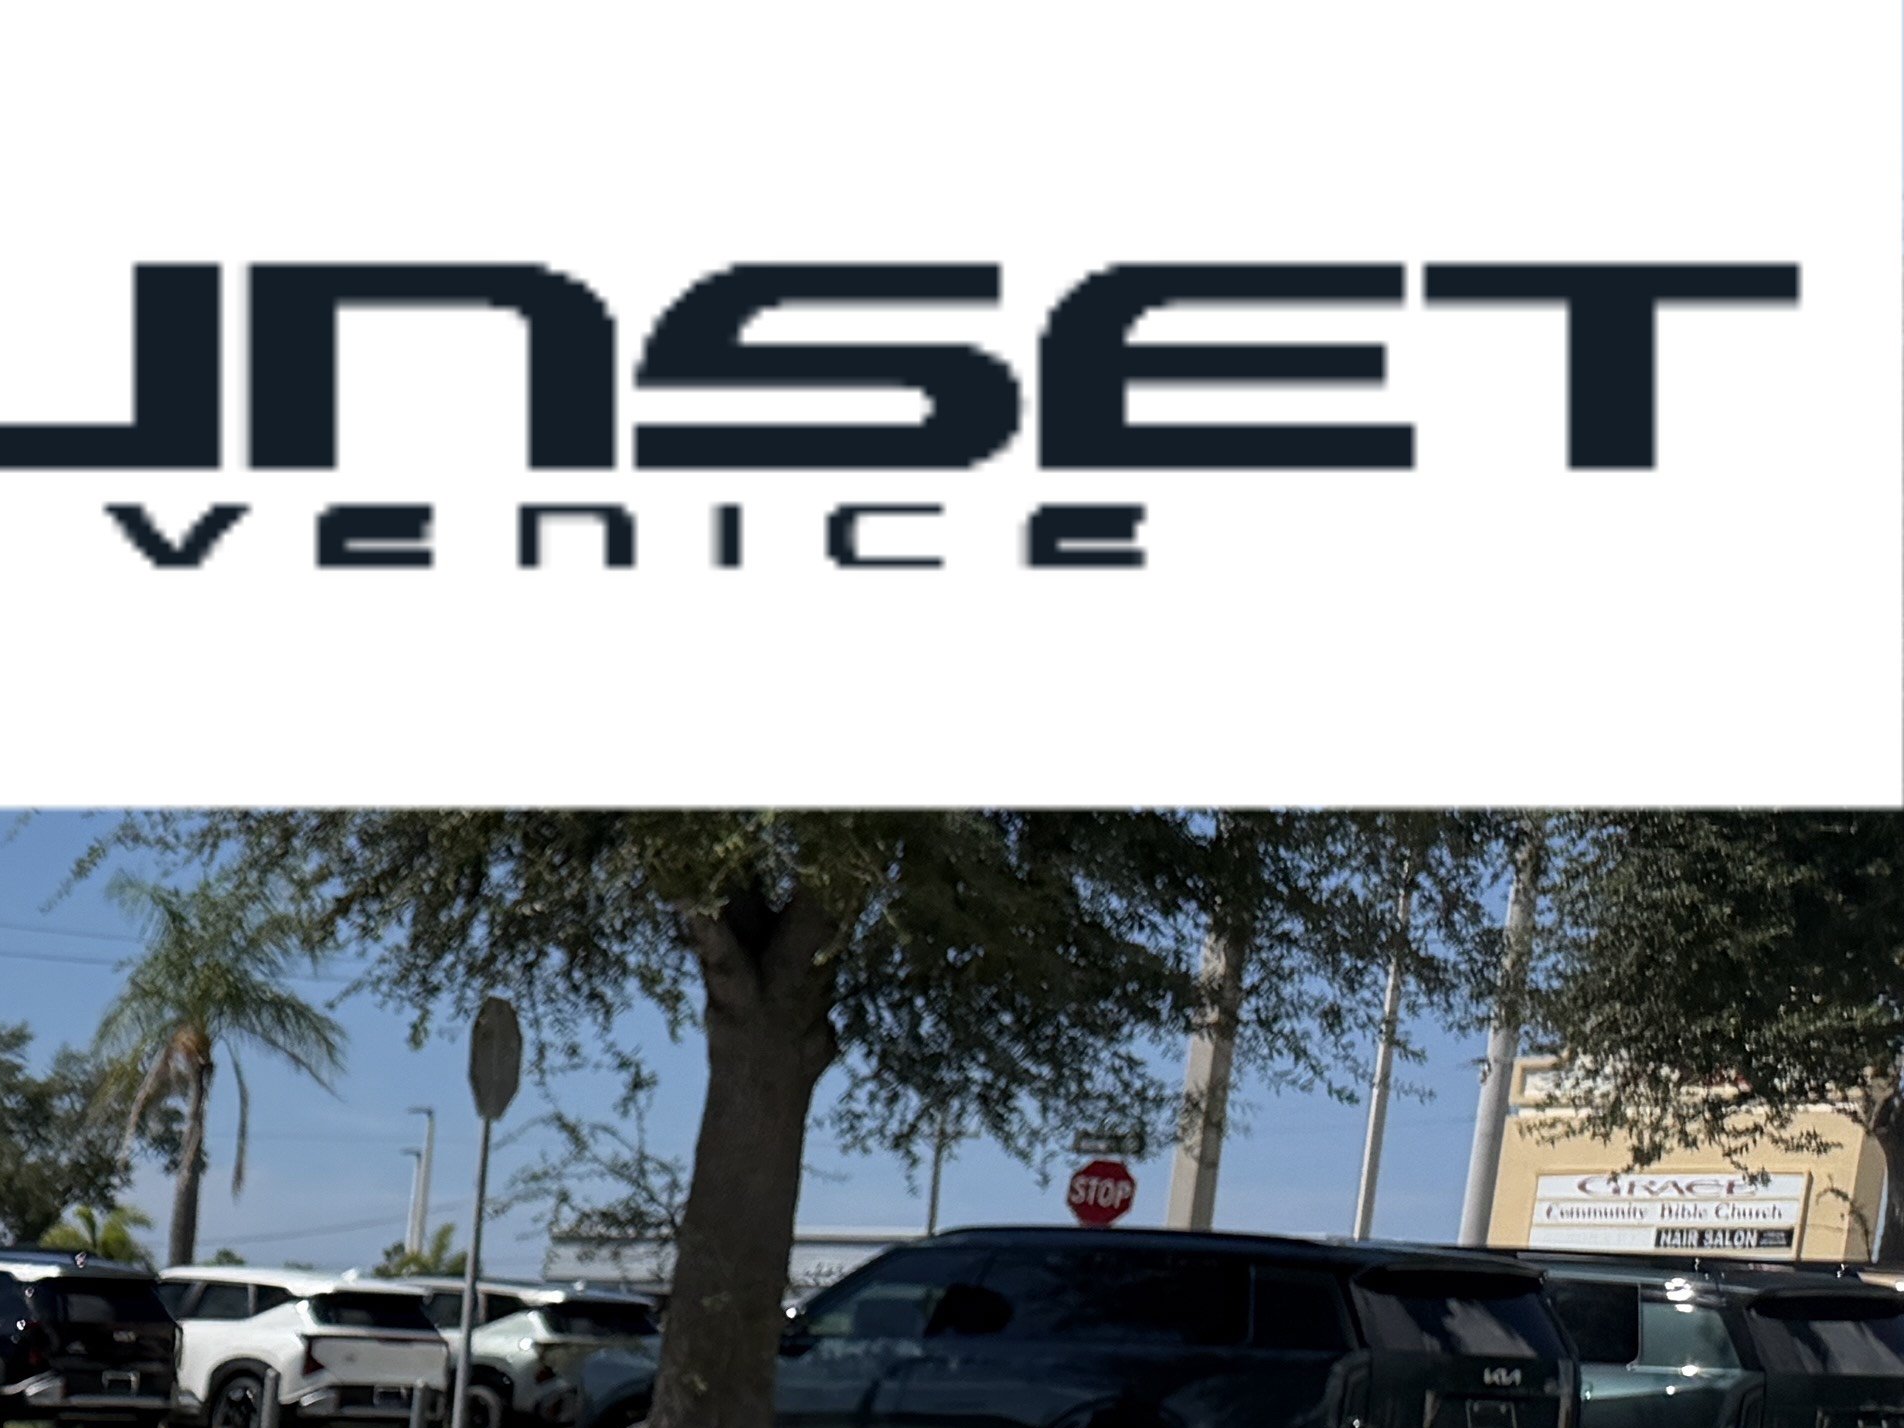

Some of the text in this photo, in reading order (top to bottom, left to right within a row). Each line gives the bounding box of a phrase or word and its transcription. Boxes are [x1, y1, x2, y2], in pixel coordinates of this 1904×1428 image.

[1070, 1175, 1132, 1209] STOP
[1714, 1202, 1783, 1221] Church
[1703, 1228, 1758, 1248] SALON
[1483, 1367, 1522, 1386] KIA
